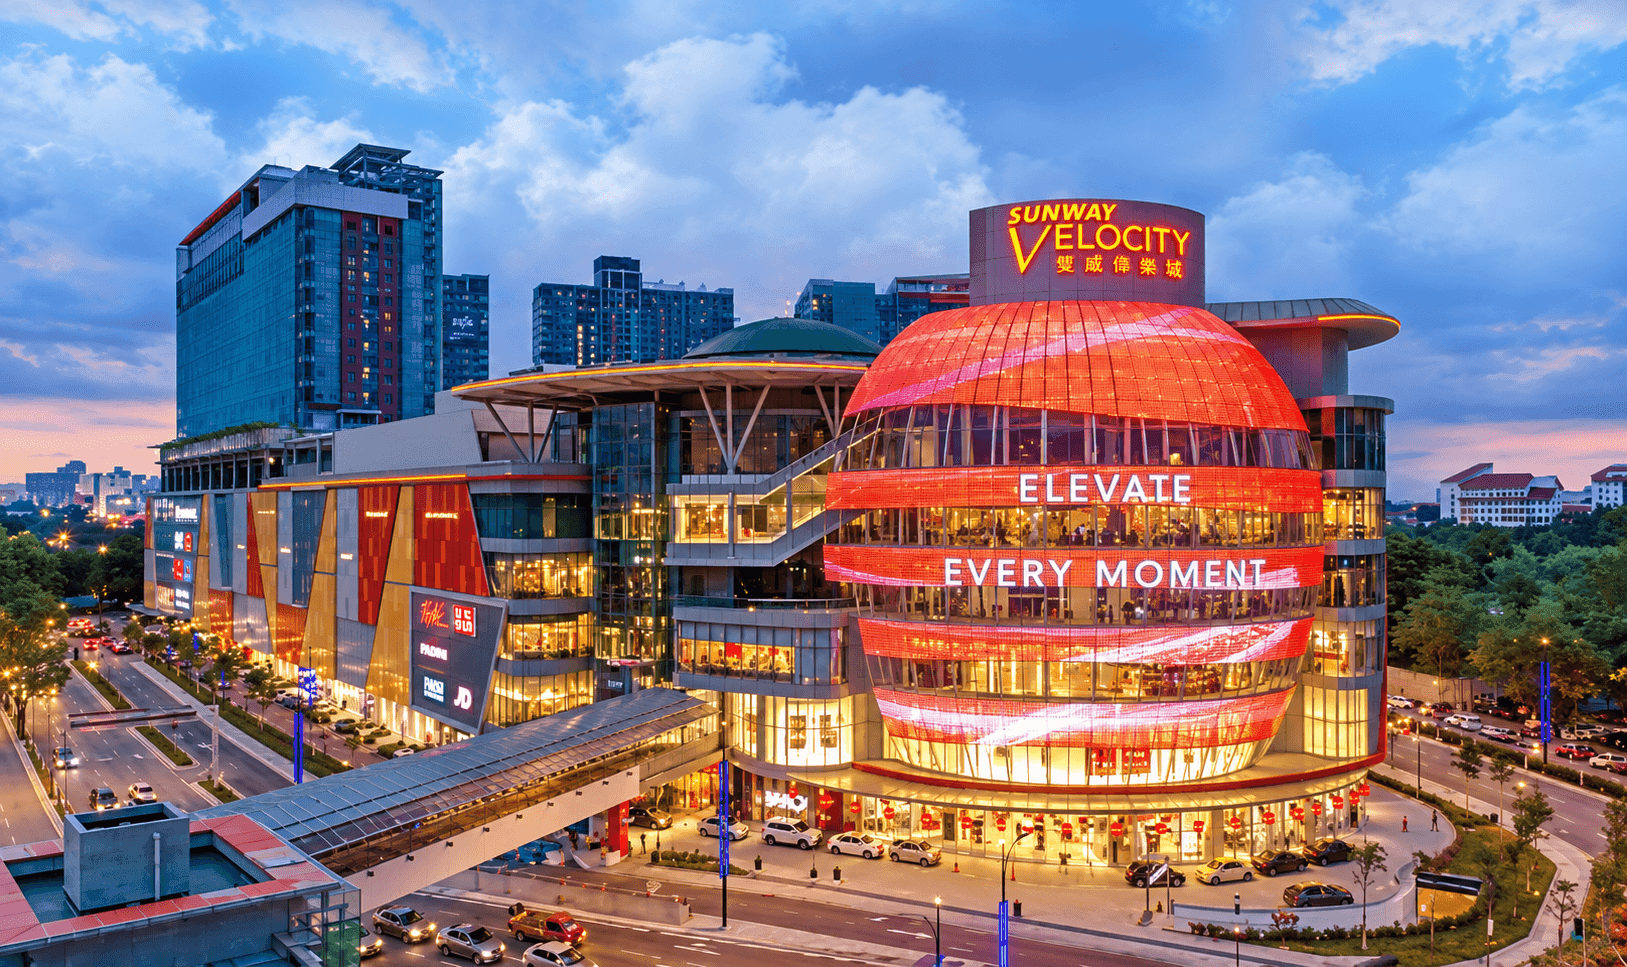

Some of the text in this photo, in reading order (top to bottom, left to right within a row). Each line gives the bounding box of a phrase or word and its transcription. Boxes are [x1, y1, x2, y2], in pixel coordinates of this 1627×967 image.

[1008, 203, 1117, 225] SUNWAY
[1008, 223, 1190, 274] VELOCITY
[1056, 254, 1184, 279] 雙威偉樂城
[1019, 473, 1192, 503] ELEVATE
[944, 557, 1267, 589] EVERY MOMENT
[453, 685, 472, 710] JD
